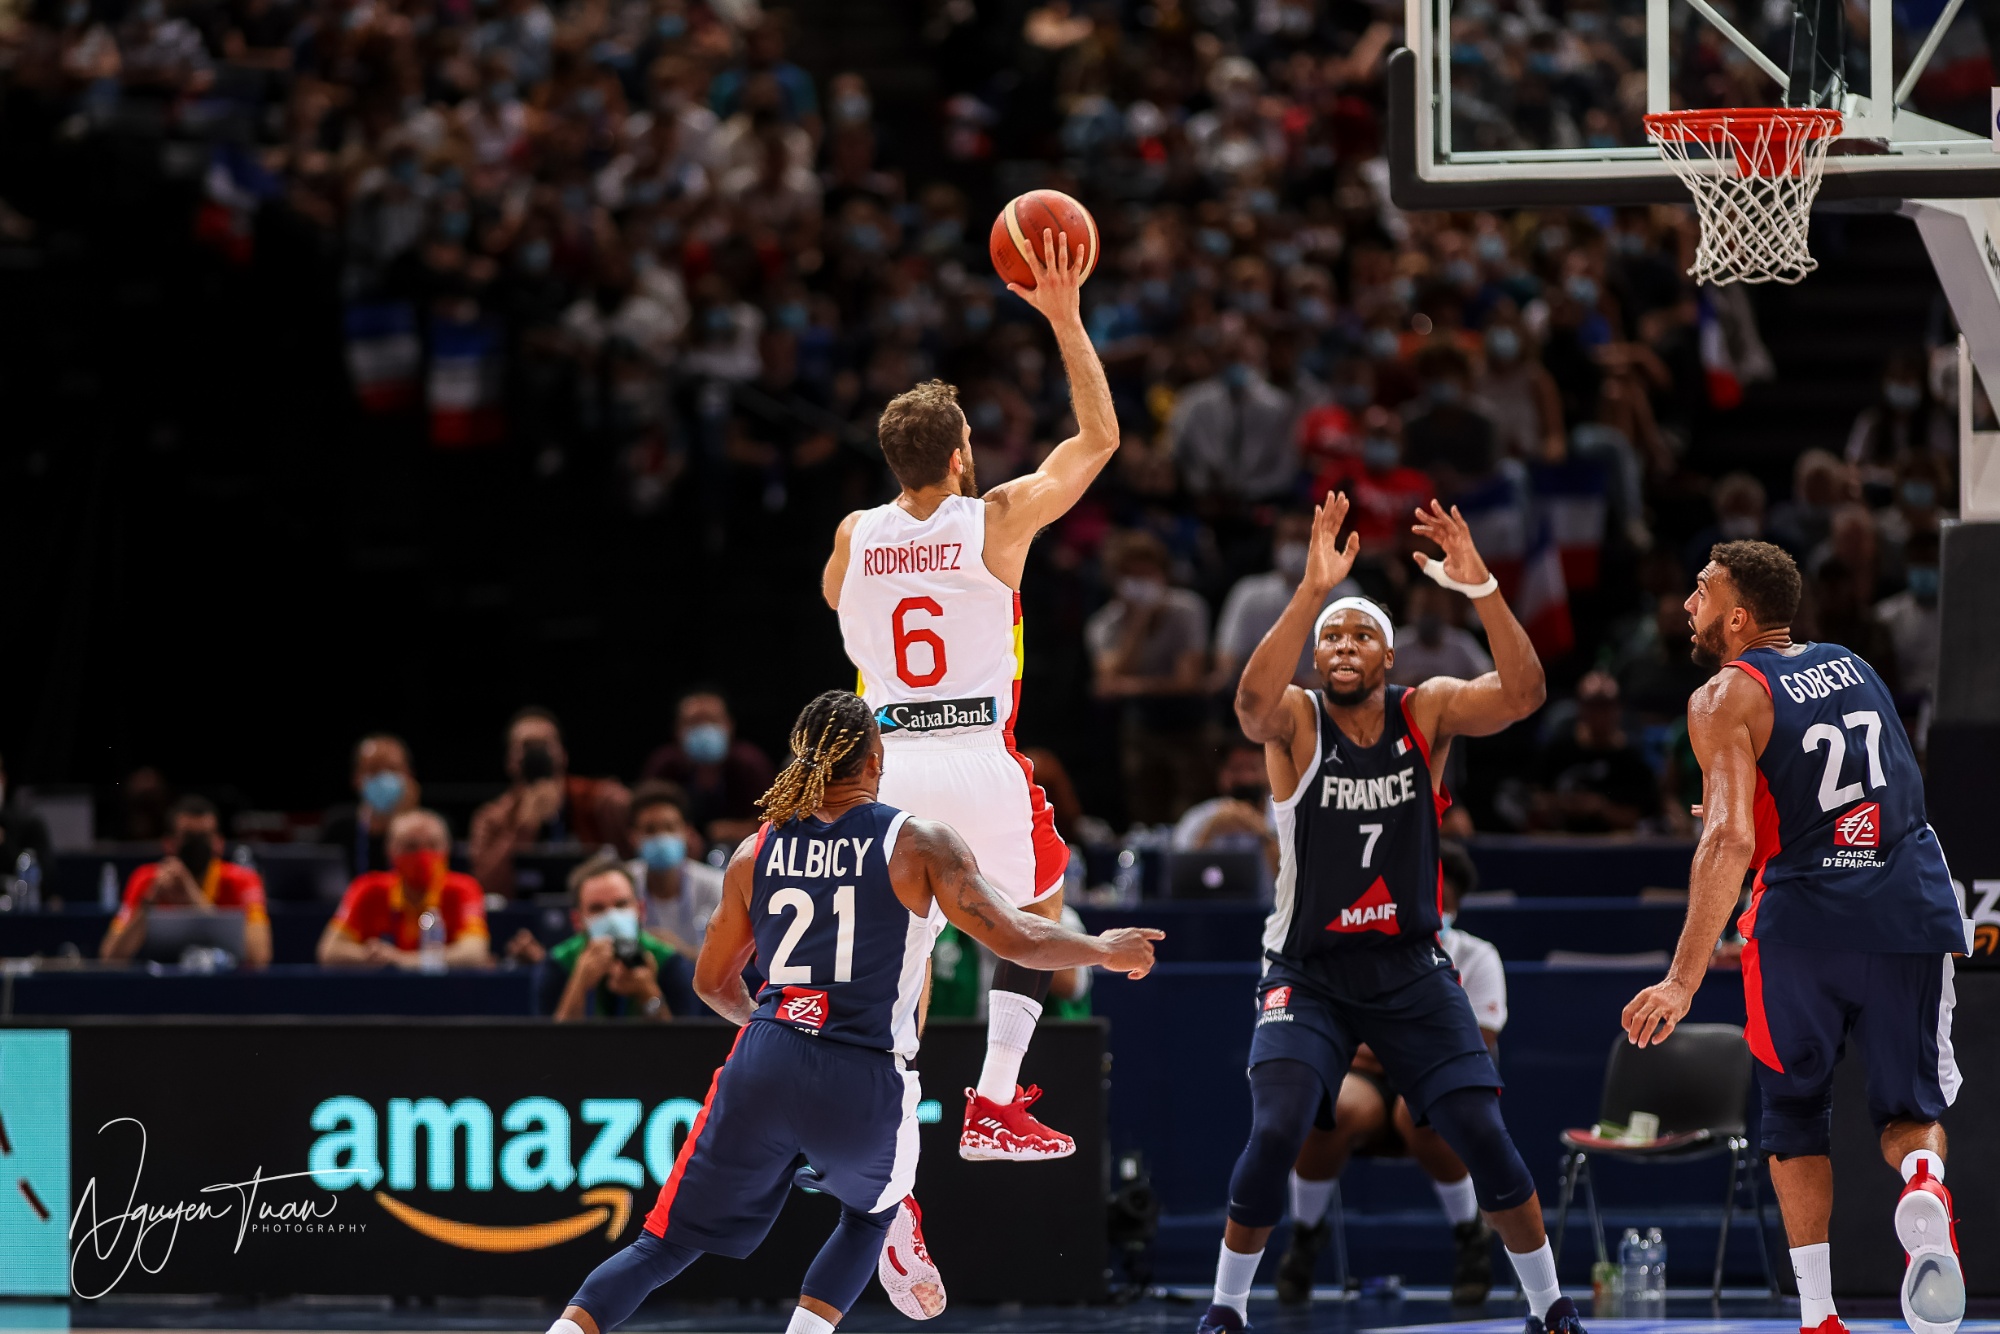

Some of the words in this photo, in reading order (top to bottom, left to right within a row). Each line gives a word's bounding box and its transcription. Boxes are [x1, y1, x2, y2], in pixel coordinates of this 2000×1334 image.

[864, 540, 962, 576] RODRÍGUEZ
[892, 596, 947, 688] 6
[1780, 656, 1865, 704] GOBERT
[892, 703, 992, 728] CaixaBank
[1802, 710, 1887, 812] 27
[1320, 767, 1416, 810] FRANCE
[766, 837, 874, 878] ALBICY
[1359, 824, 1383, 868] 7
[1837, 850, 1877, 860] CAISSE
[768, 885, 855, 985] 21
[1341, 903, 1397, 926] MAIF
